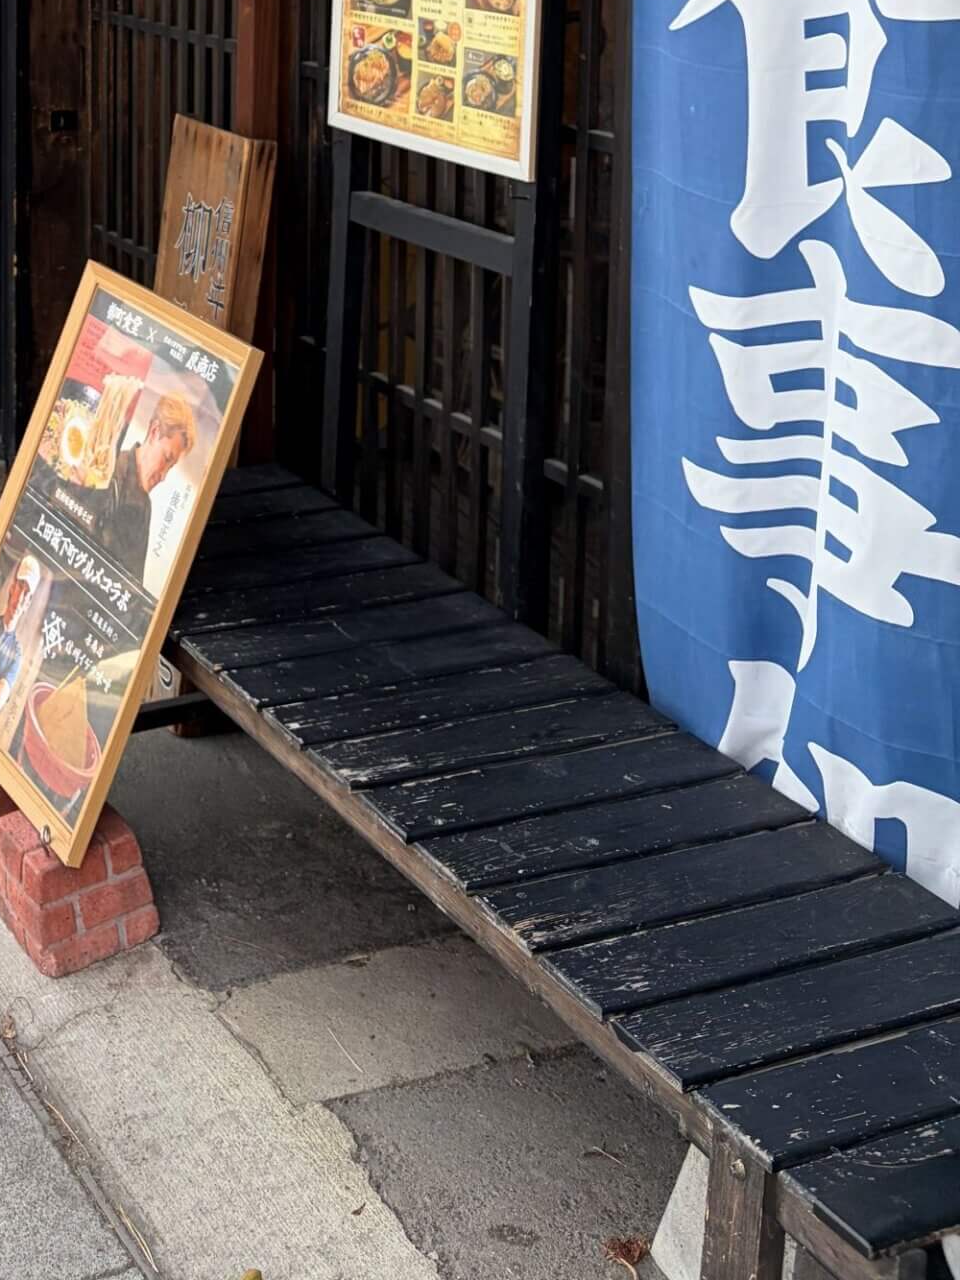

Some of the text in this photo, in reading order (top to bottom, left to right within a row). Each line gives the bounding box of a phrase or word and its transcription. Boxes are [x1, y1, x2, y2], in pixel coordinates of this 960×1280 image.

[174, 191, 214, 310] 柳
[32, 513, 132, 612] 上田城下町グルメコラボ
